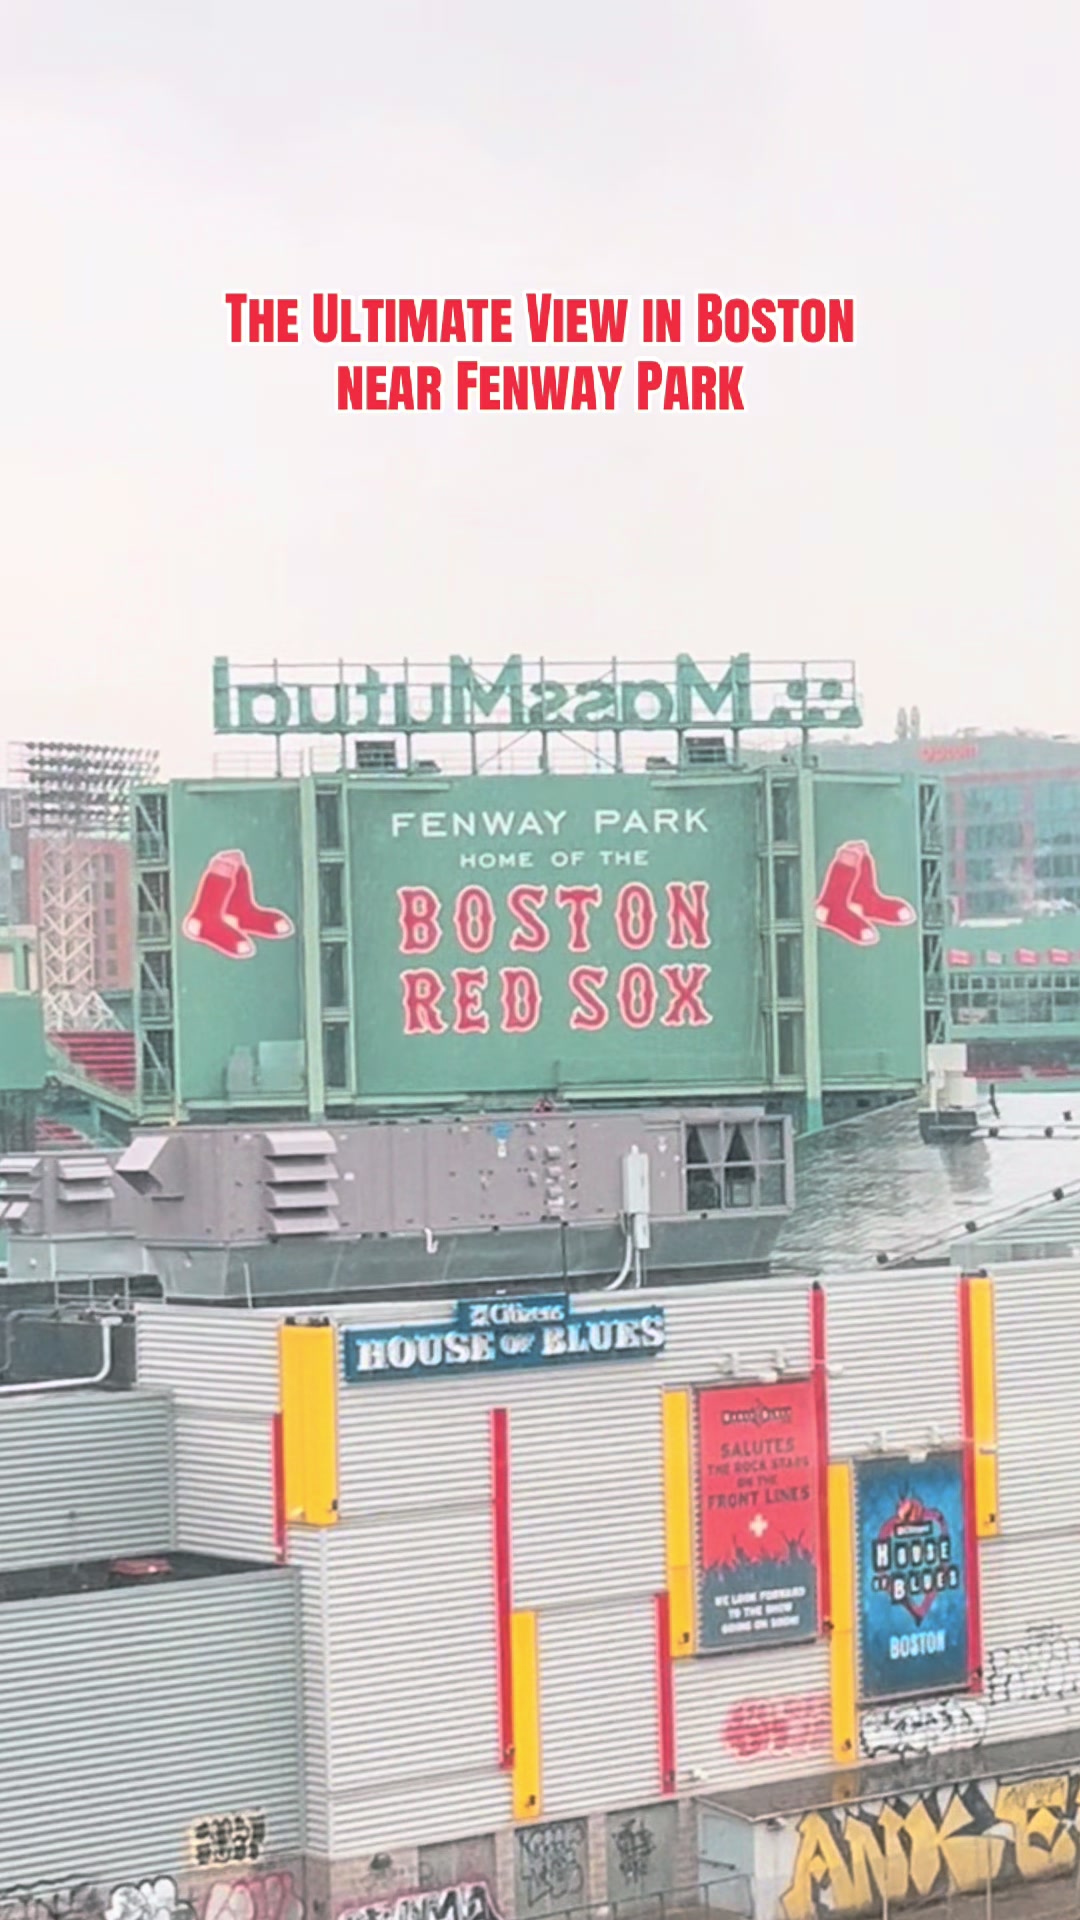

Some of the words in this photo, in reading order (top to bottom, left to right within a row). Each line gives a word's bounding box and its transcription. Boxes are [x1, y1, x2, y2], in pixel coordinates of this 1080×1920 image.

[391, 808, 568, 838] FENWAY
[594, 807, 709, 834] PARK
[459, 851, 534, 869] HOME
[550, 850, 586, 867] OF
[599, 849, 649, 866] THE
[397, 880, 711, 953] BOSTON
[400, 966, 542, 1034] RED
[569, 963, 713, 1031] SOX
[356, 1330, 496, 1373] HOUSE
[541, 1315, 666, 1357] BLUES
[721, 1437, 795, 1459] SALUTES
[707, 1490, 759, 1509] FRONT
[765, 1484, 811, 1505] LINES
[889, 1629, 946, 1660] BOSTON
